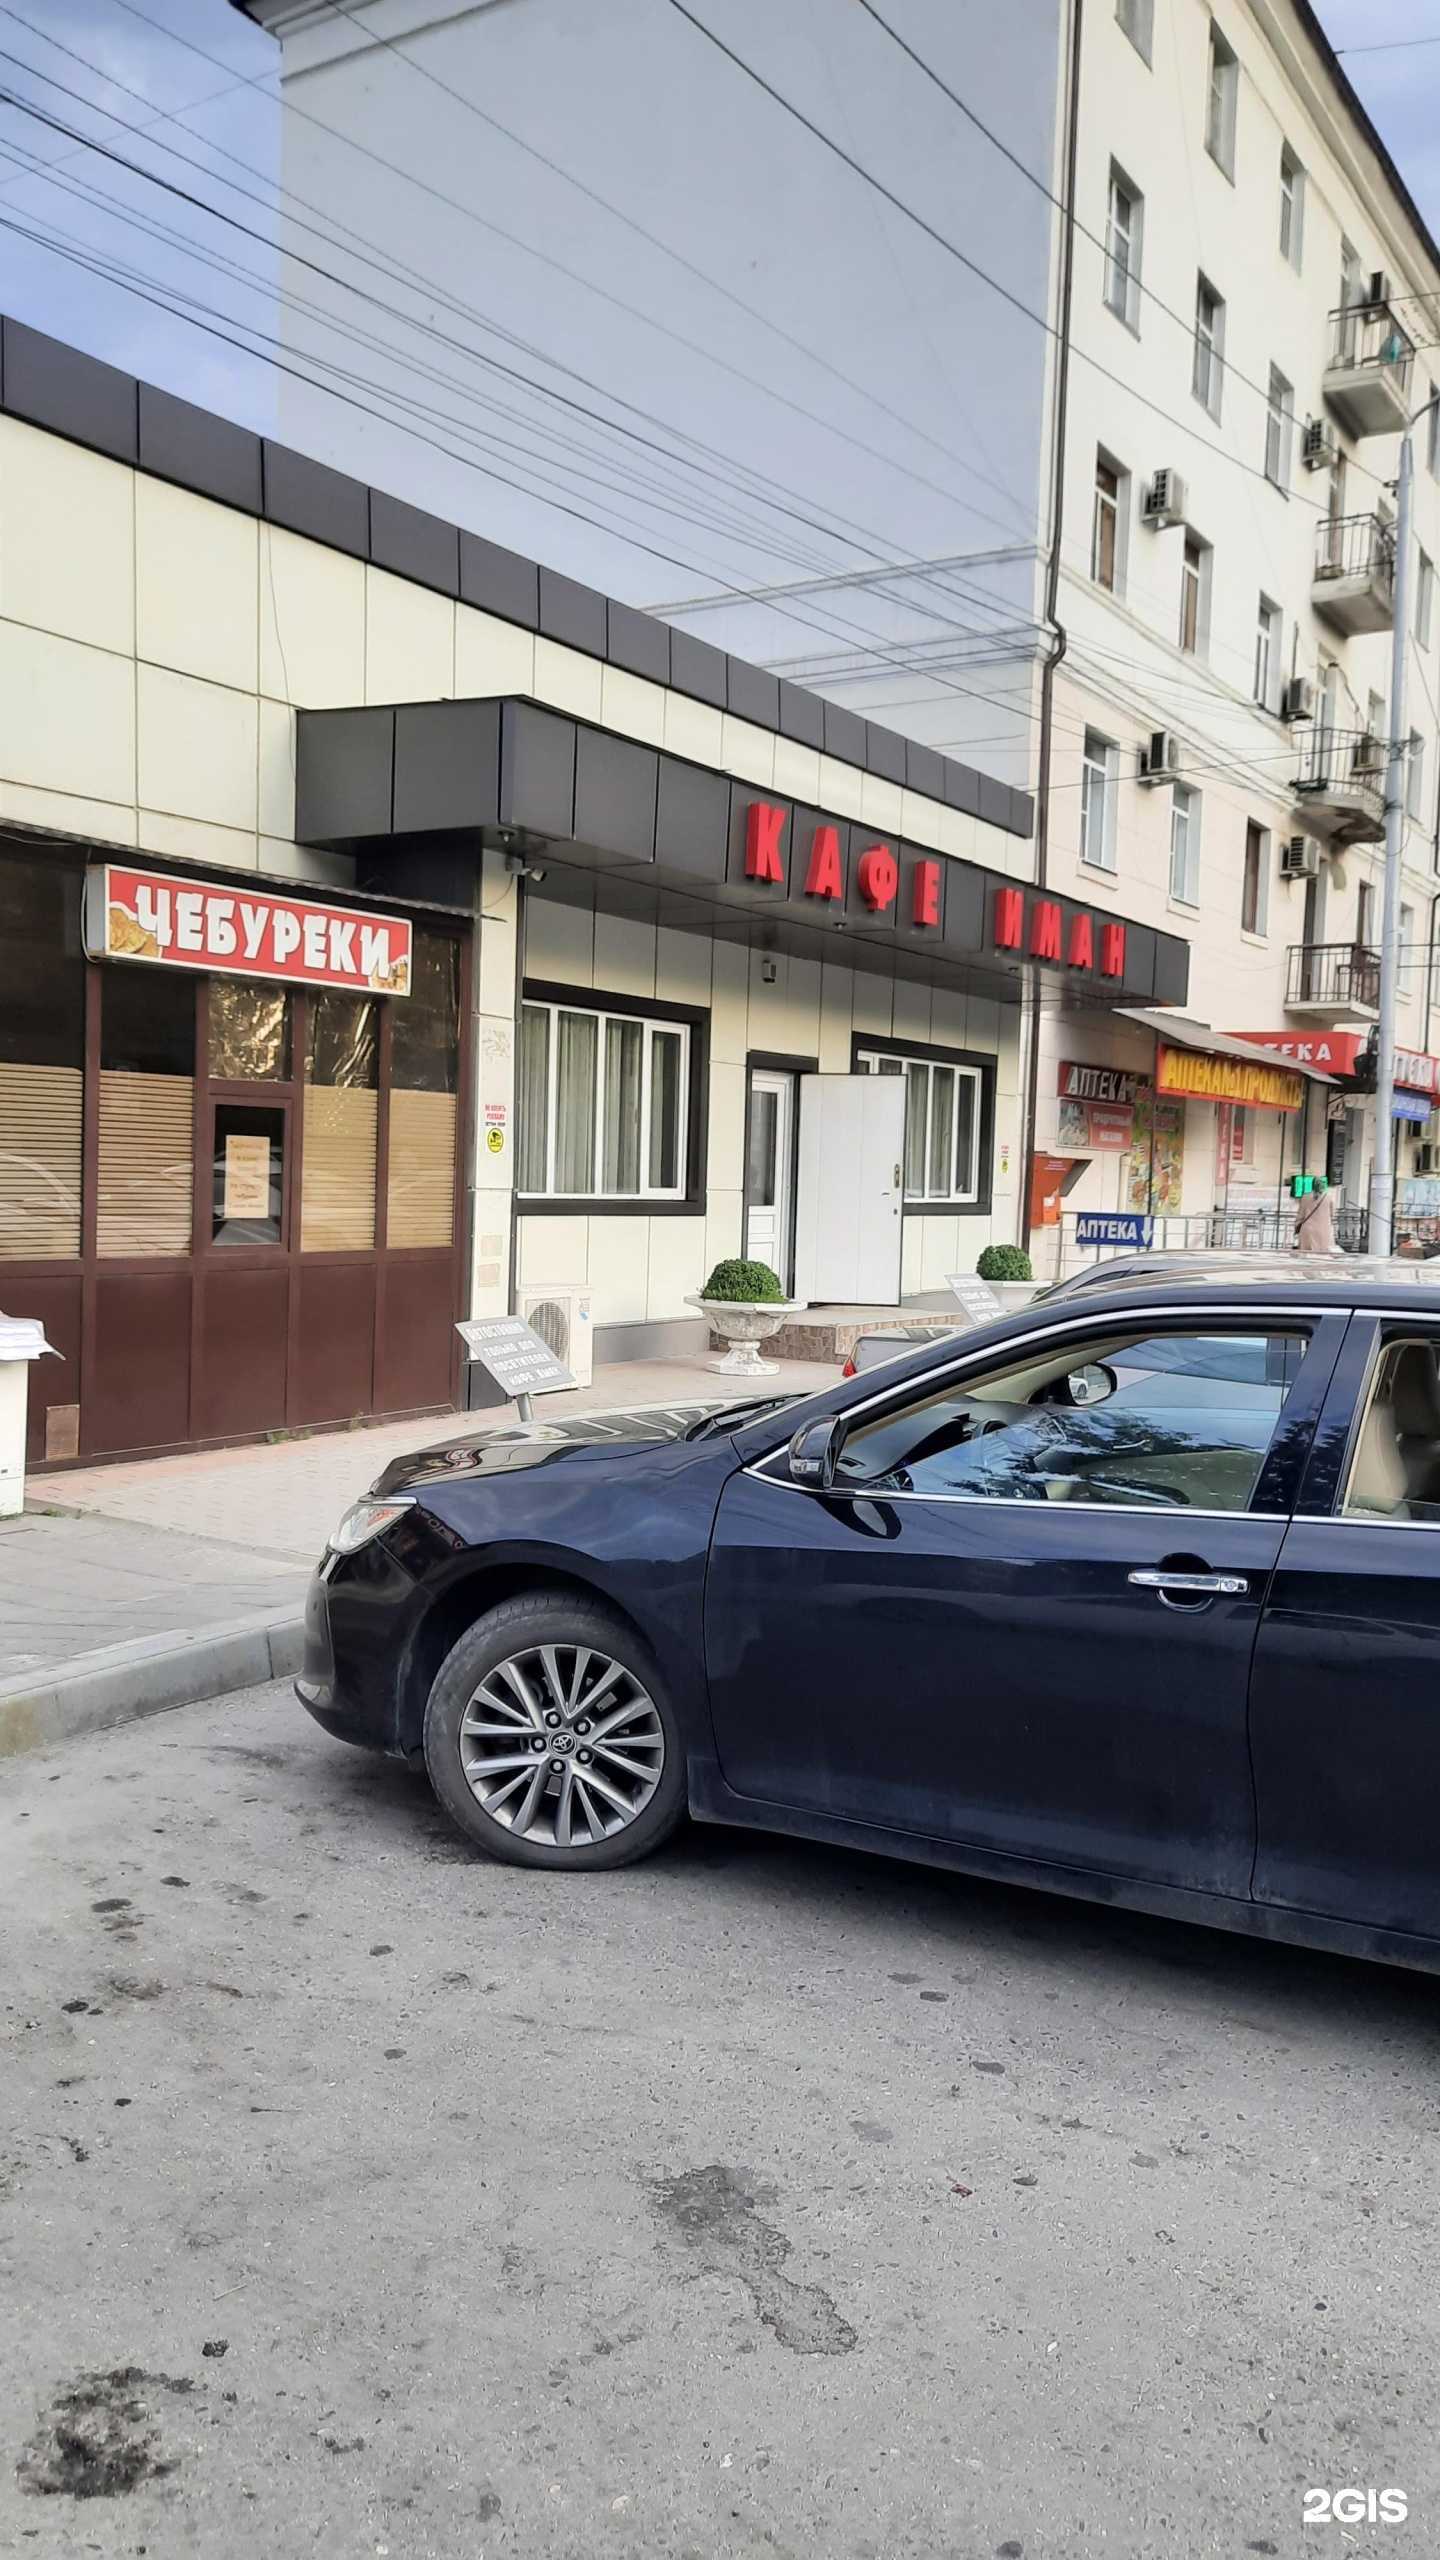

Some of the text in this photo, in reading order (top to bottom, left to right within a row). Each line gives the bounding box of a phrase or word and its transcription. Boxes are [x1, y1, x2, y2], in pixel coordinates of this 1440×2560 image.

[746, 801, 1126, 977] КАФЕ ИМАН
[135, 884, 392, 978] ЧЕБУРЕКИ
[1067, 1066, 1127, 1101] АПТЕКА
[1077, 1219, 1138, 1240] АПТЕКА
